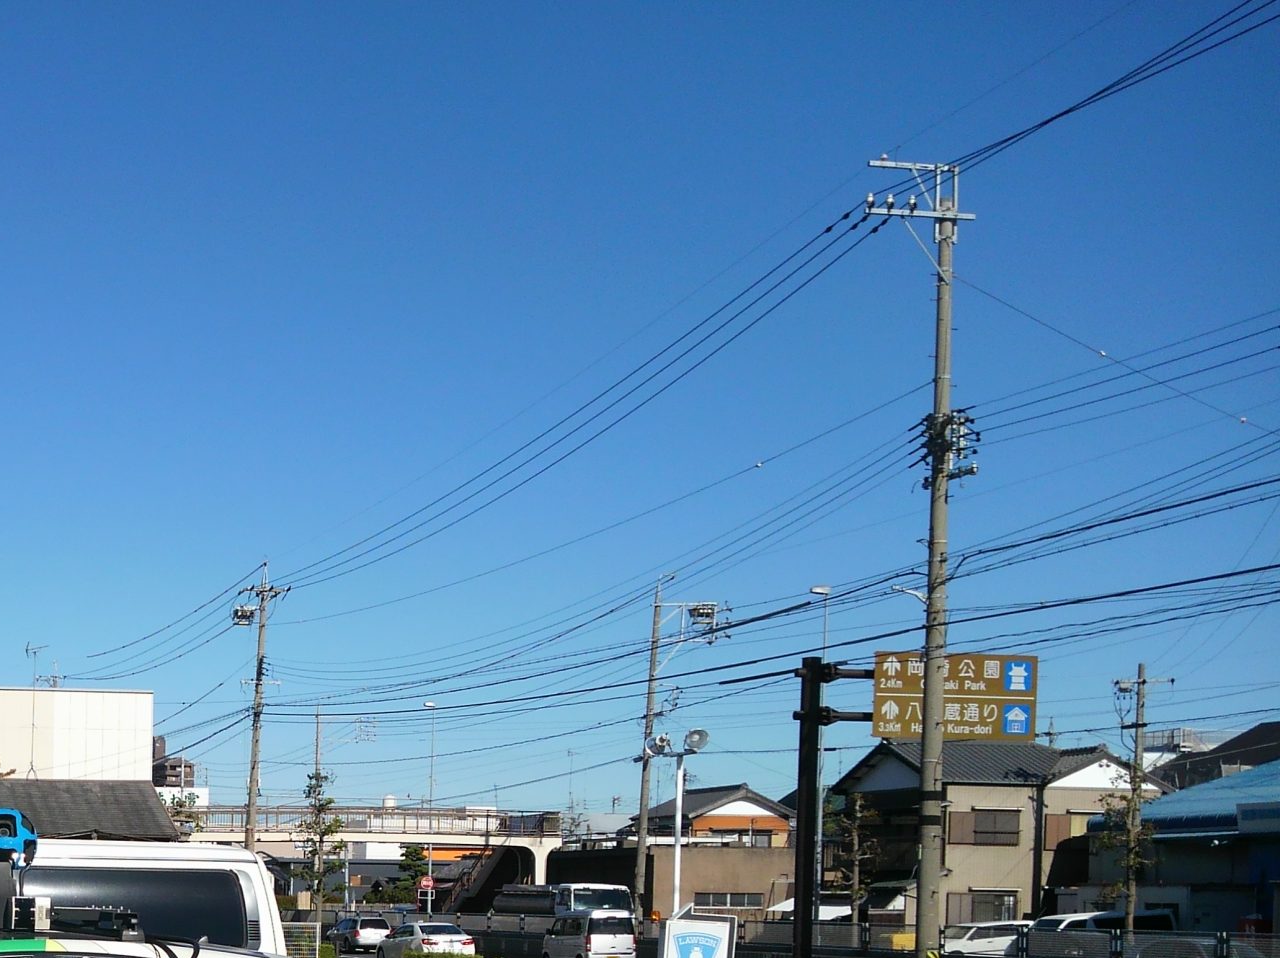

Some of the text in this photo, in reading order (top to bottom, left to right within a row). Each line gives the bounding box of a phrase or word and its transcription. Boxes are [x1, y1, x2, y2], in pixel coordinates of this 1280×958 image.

[965, 681, 986, 691] Park
[906, 702, 998, 722] 八蔵通り
[948, 724, 992, 734] Kura-dori
[679, 936, 718, 948] LAWSON
